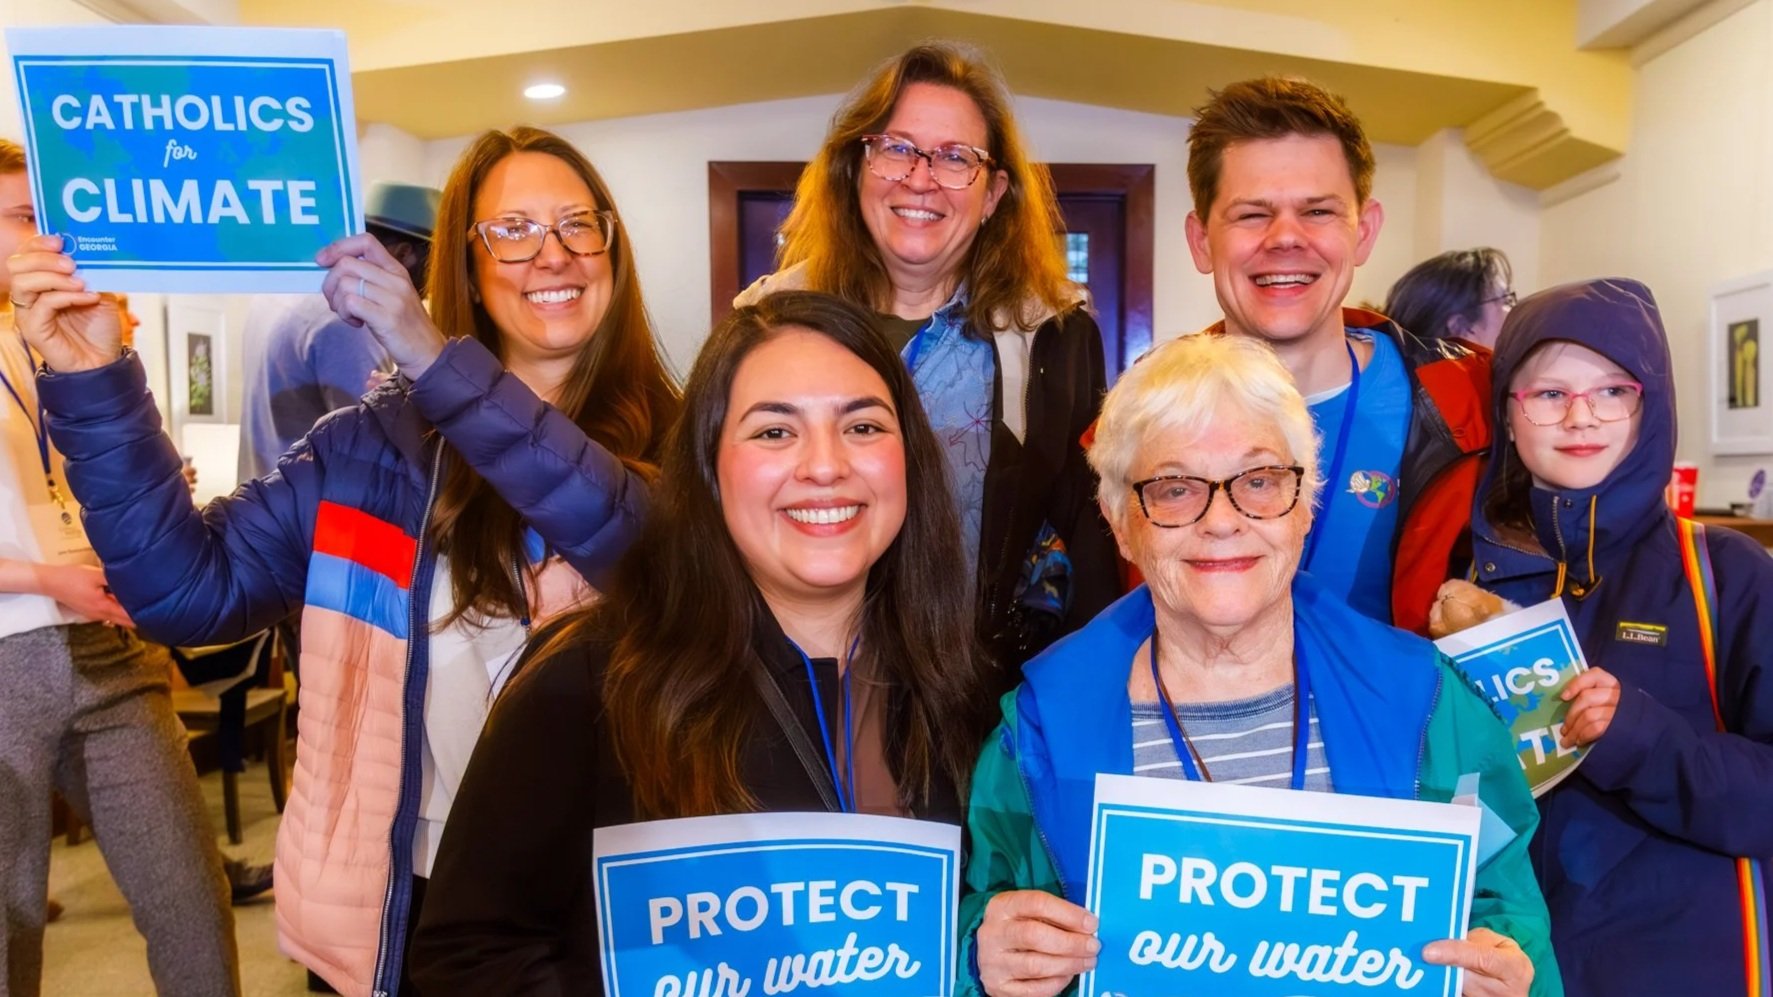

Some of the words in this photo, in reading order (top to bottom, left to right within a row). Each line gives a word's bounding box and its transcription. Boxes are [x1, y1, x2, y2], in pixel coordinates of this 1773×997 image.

[51, 94, 314, 132] CATHOLICS
[163, 139, 197, 168] for
[62, 177, 320, 225] CLIMATE
[79, 243, 118, 251] GEORGIA
[1622, 632, 1659, 643] L.L.Bean
[1139, 853, 1429, 922] PROTECT
[648, 879, 919, 945] PROTECT
[653, 961, 751, 997] our
[763, 932, 921, 995] water
[1129, 930, 1237, 973] our
[1248, 930, 1424, 989] water
